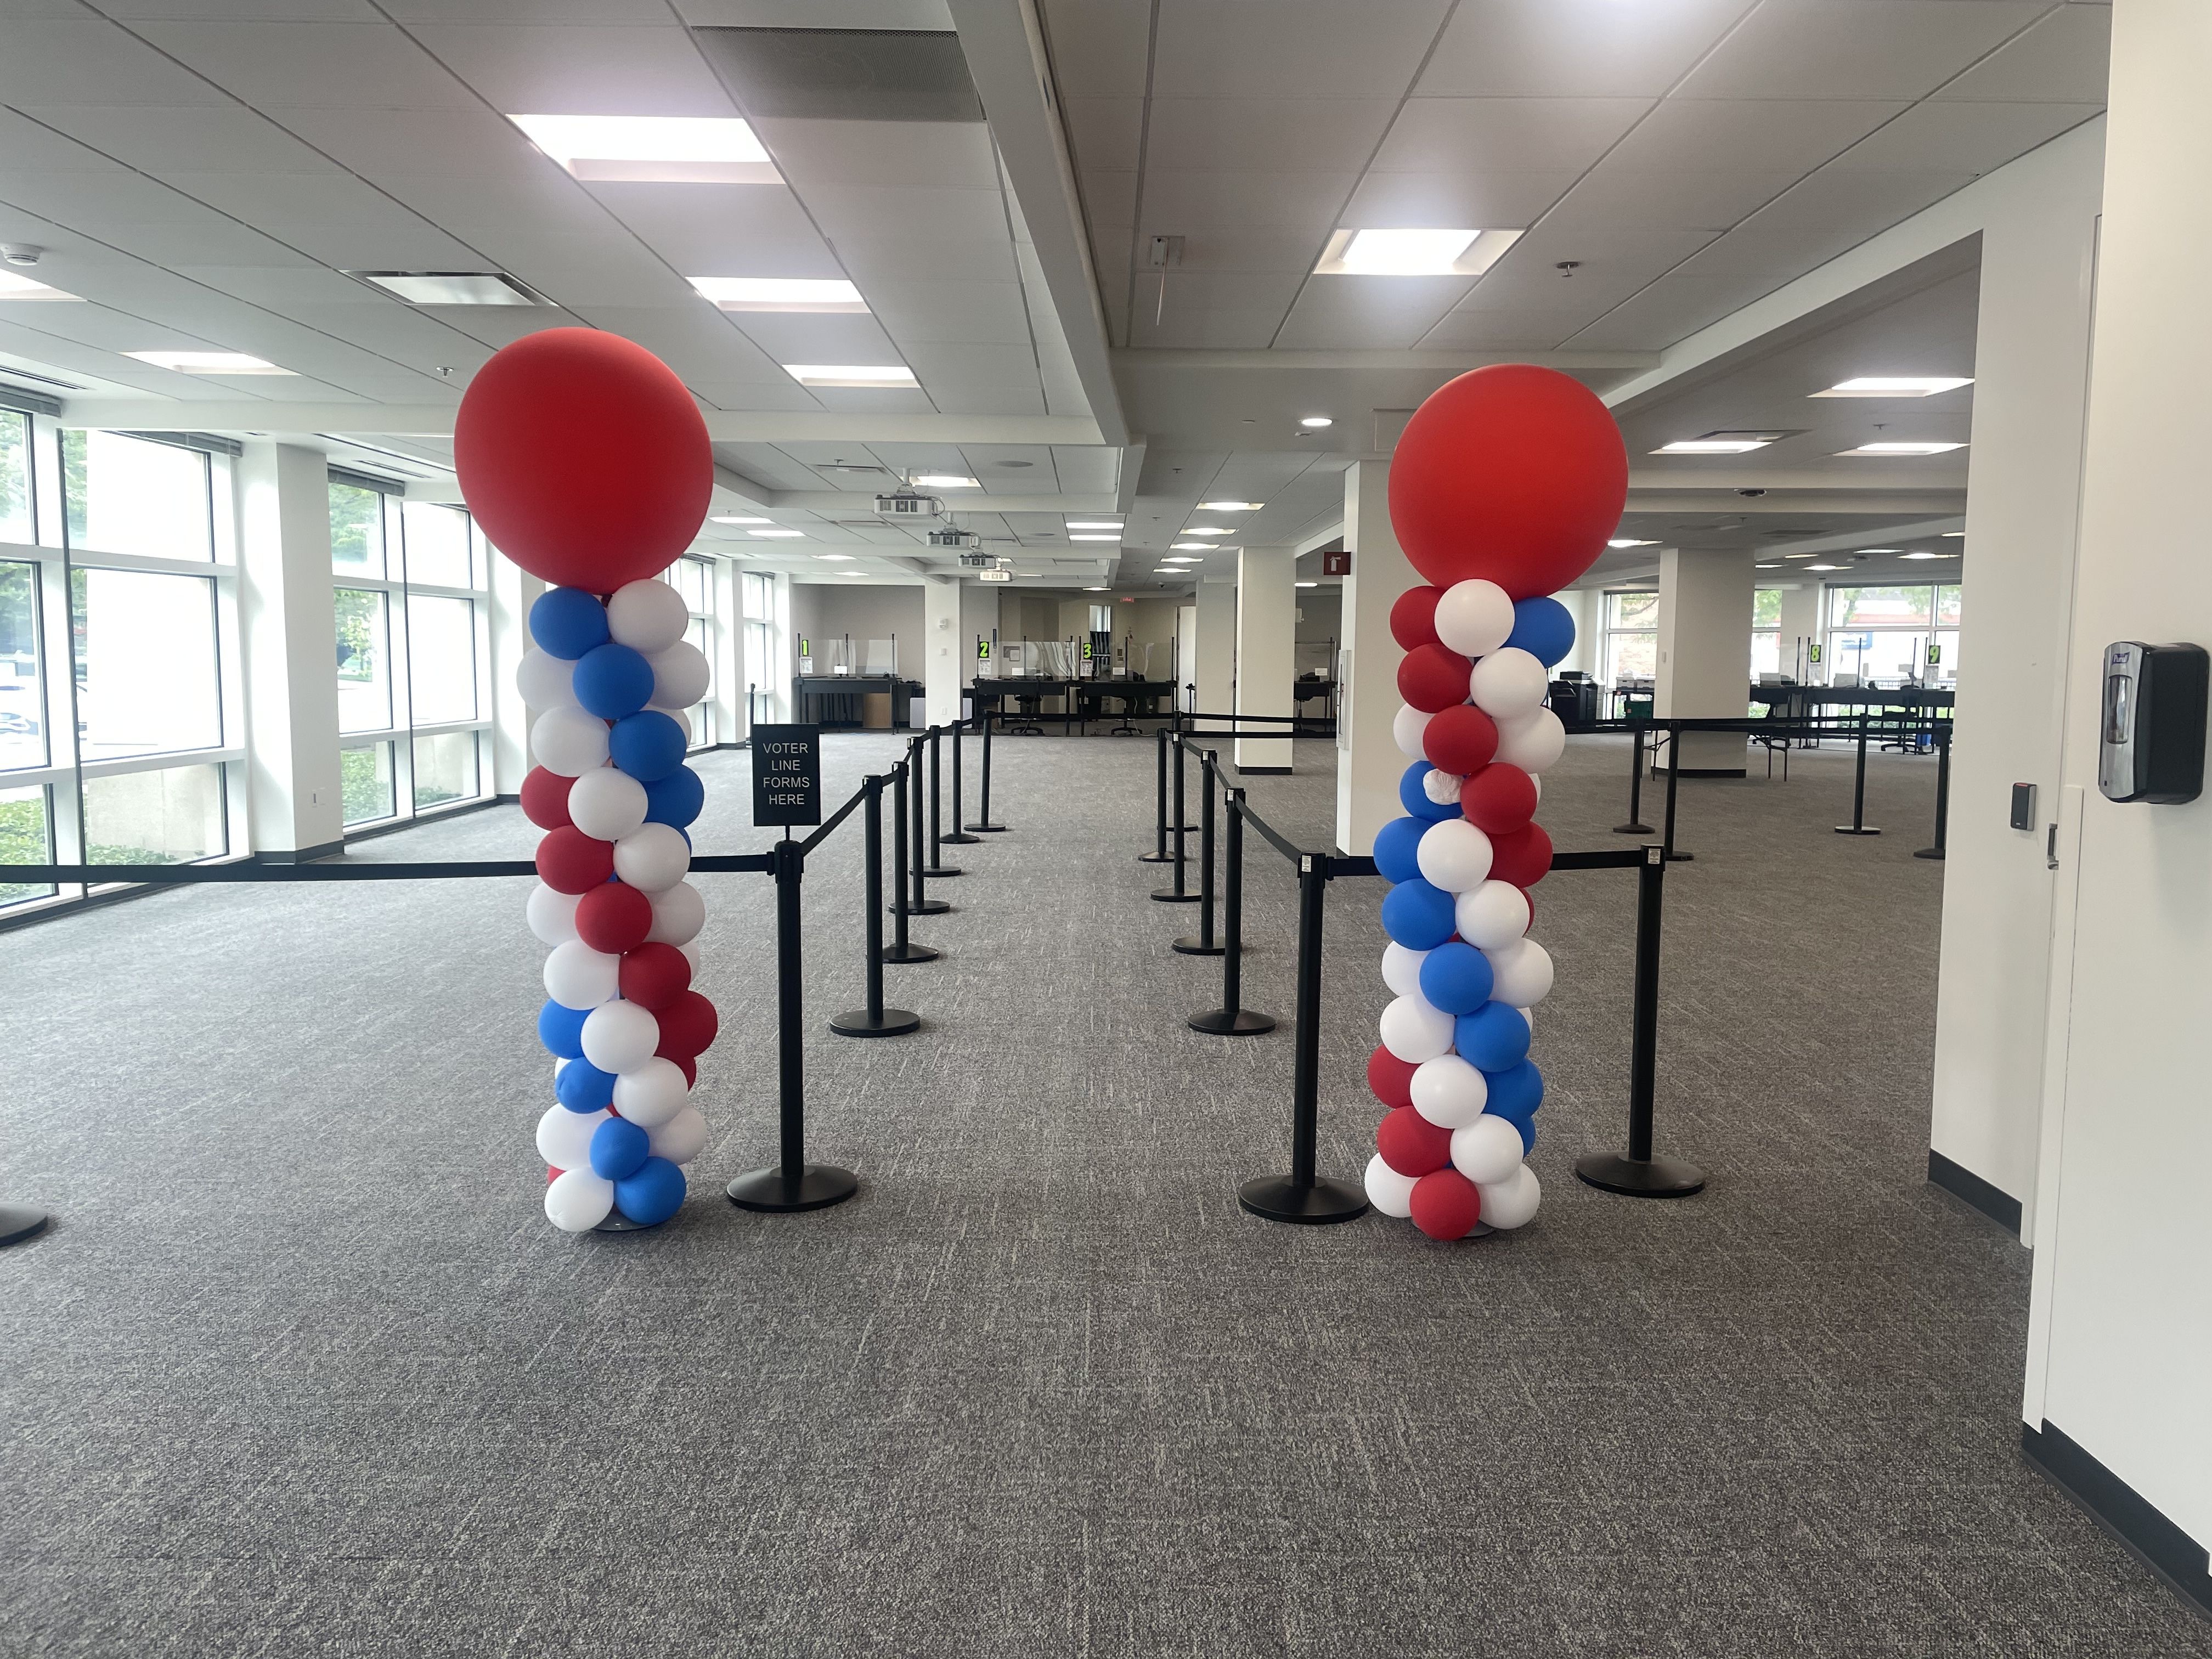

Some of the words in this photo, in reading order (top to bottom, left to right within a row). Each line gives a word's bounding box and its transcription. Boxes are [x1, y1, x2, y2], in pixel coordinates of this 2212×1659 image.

[980, 642, 988, 657] 2
[1084, 644, 1091, 658] 3
[1811, 645, 1820, 662] 8
[1929, 646, 1939, 663] 9
[763, 743, 808, 754] VOTER
[771, 760, 800, 771] LINE
[763, 777, 810, 788] FORMS
[769, 794, 805, 805] HERE
